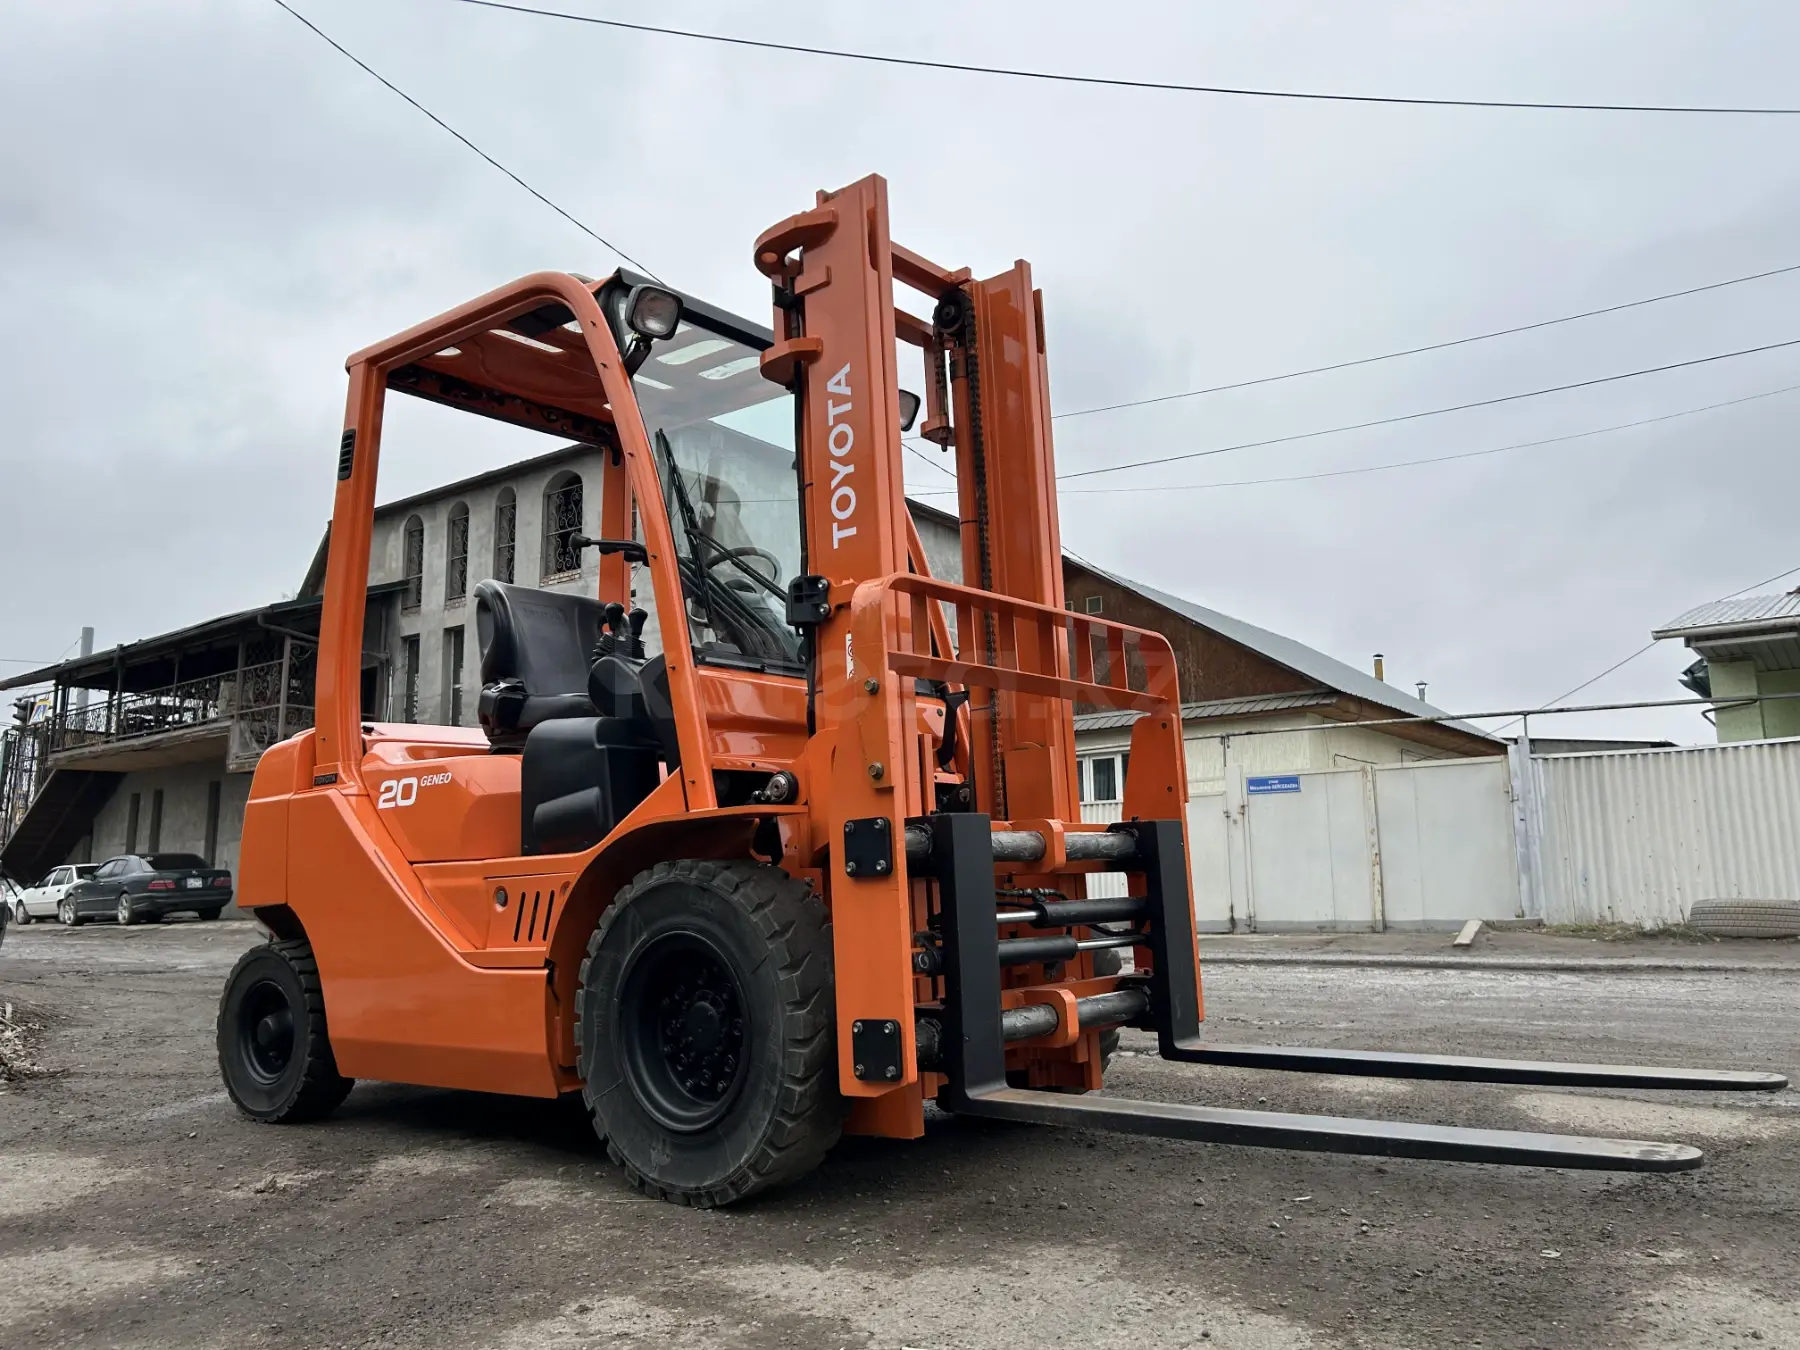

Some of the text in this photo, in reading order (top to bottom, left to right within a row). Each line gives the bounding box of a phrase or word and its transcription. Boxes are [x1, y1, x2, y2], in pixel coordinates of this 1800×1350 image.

[827, 362, 857, 550] TOYOTA
[377, 771, 452, 809] 20 GENEO
